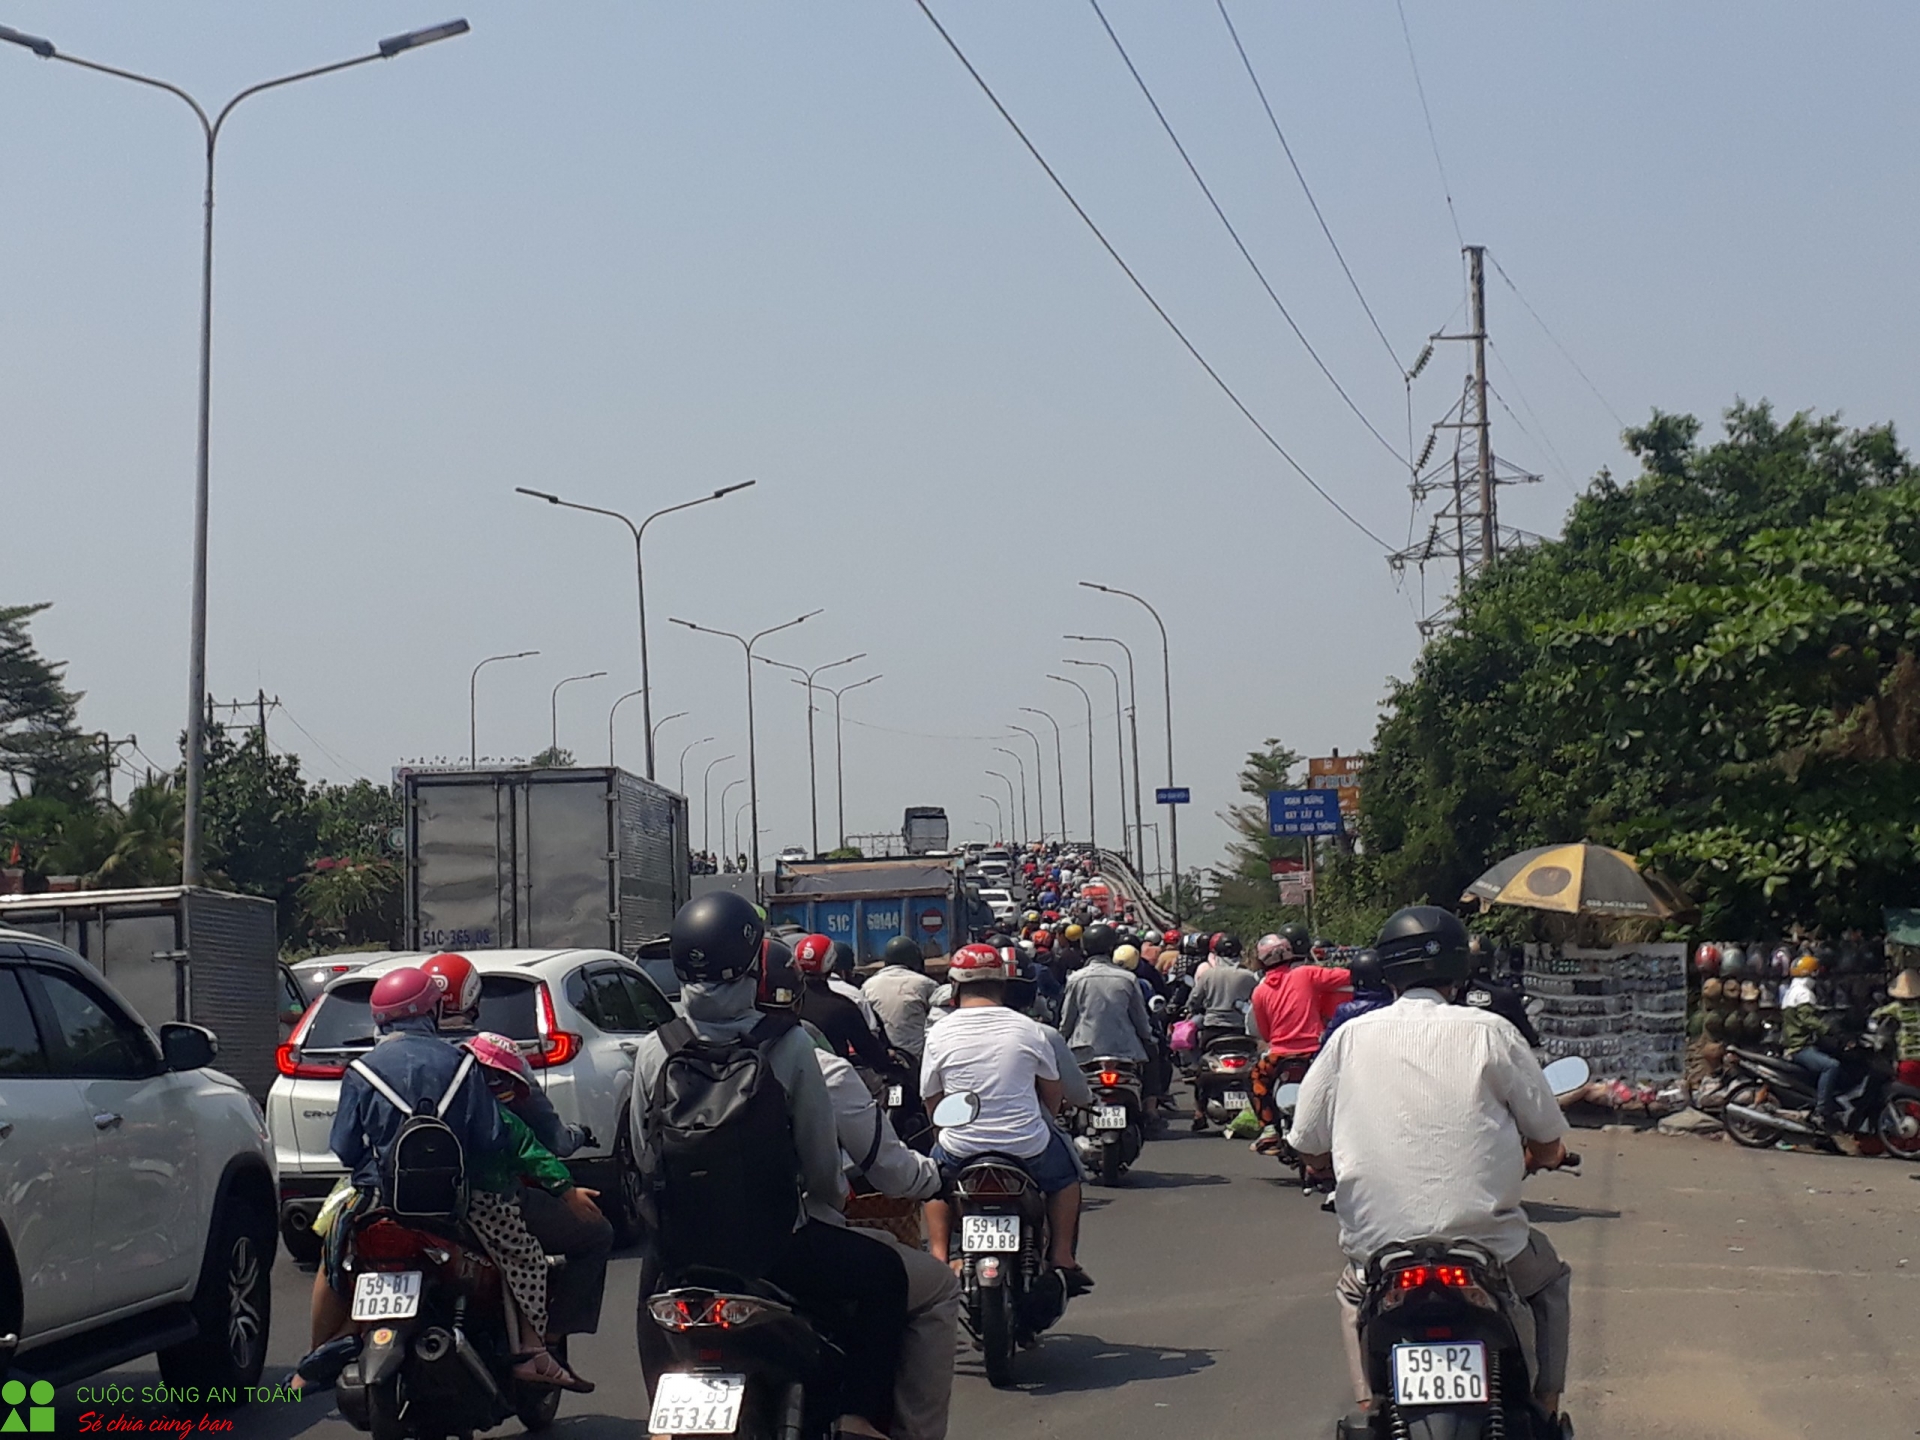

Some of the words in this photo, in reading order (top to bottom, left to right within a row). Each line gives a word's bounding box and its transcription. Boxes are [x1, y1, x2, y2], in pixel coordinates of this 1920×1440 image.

[827, 914, 850, 932] 51C
[972, 1218, 1011, 1233] 59-L2
[967, 1234, 1016, 1249] 679.88
[358, 1295, 415, 1316] 103.67
[1407, 1347, 1472, 1373] 59-P2
[1402, 1374, 1482, 1401] 448.60
[656, 1406, 733, 1430] 653.41
